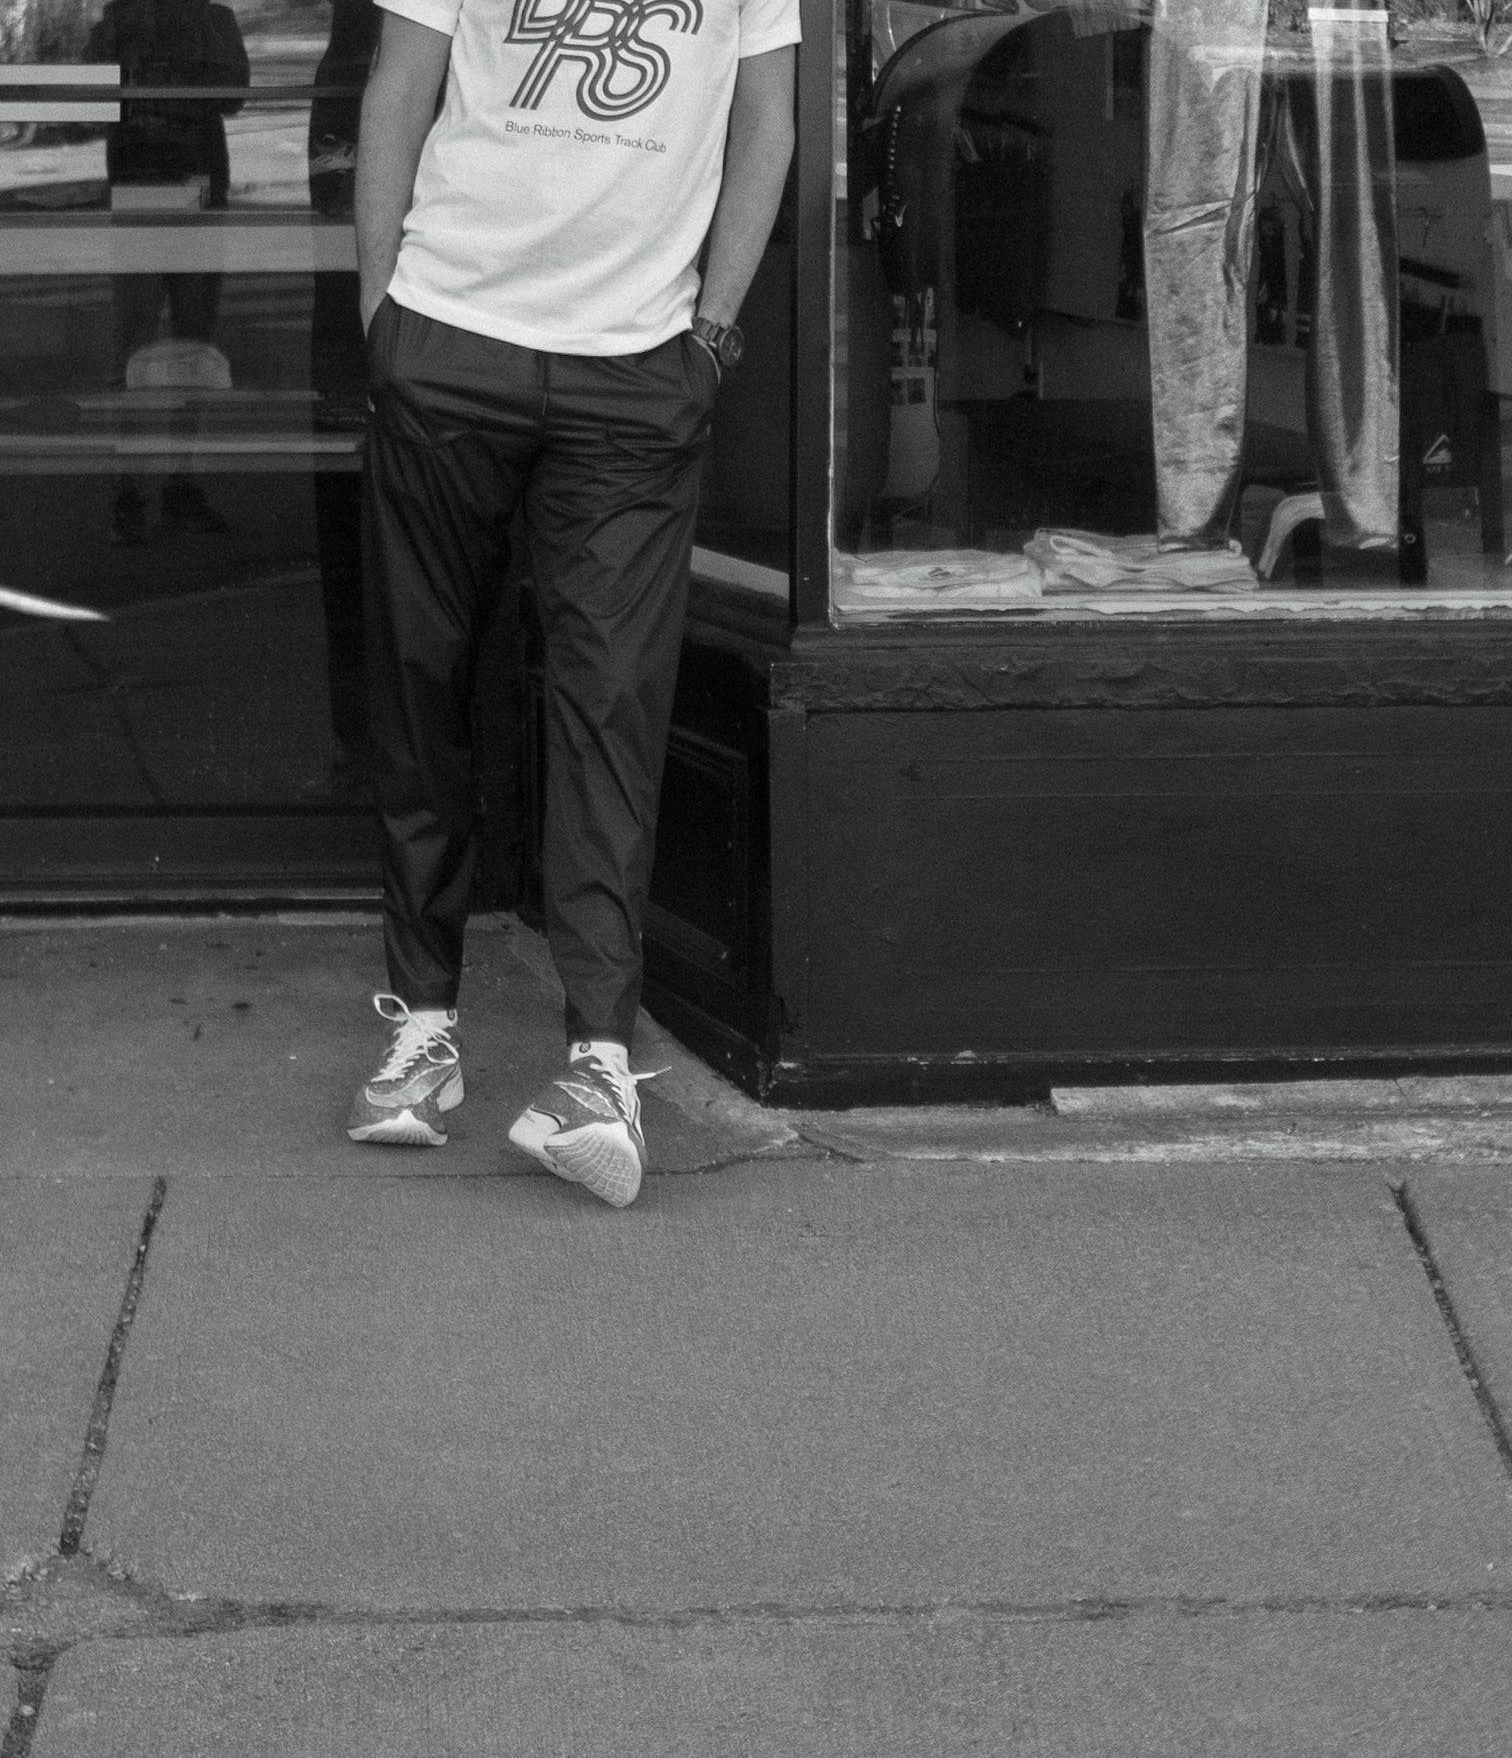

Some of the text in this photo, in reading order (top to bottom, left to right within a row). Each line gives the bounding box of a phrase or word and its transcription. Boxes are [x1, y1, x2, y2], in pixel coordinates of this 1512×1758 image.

[505, 120, 667, 154] Blue Ribbon Sports Track Club
